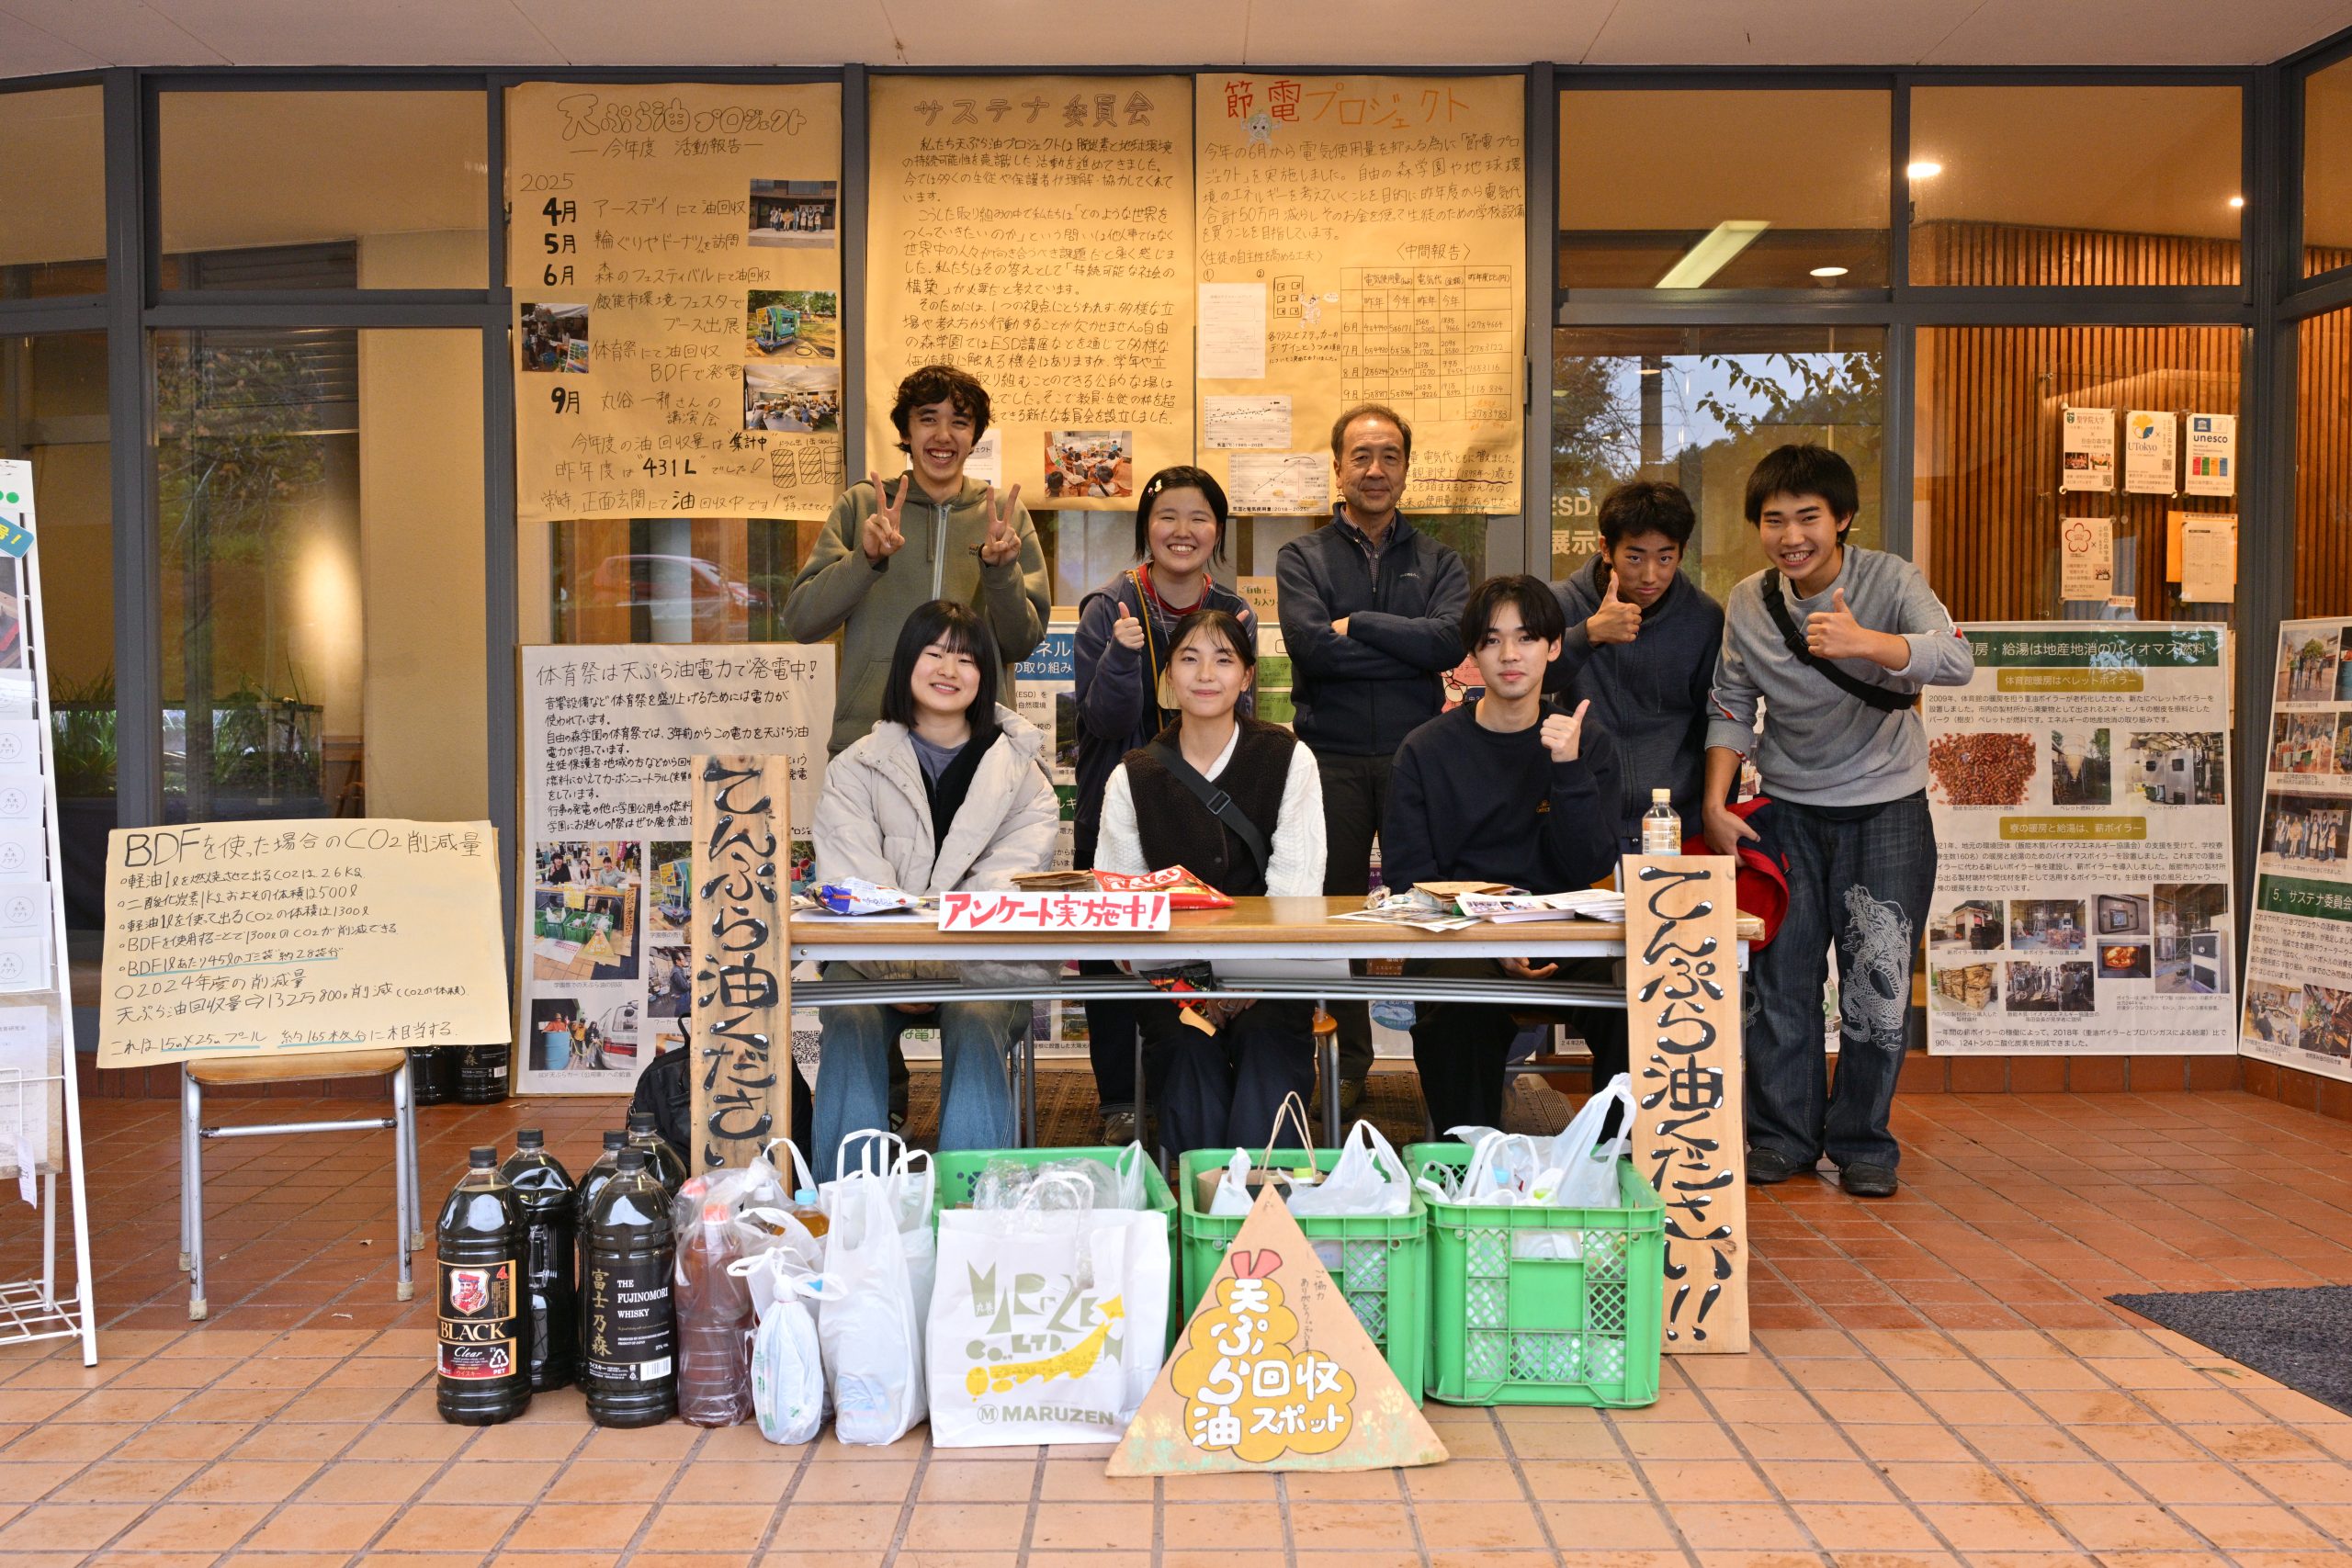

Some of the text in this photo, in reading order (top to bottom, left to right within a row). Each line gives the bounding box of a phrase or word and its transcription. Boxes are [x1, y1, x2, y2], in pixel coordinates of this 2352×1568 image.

[520, 172, 575, 192] 2025
[542, 197, 577, 227] 4月
[544, 233, 577, 254] 5月
[543, 264, 574, 287] 6月
[1343, 322, 1358, 333] 6月
[1343, 346, 1358, 355] 7月
[1343, 367, 1359, 378] 8月
[550, 387, 581, 414] 9月
[1344, 389, 1358, 399] 9月
[2128, 442, 2157, 452] UTokyo
[2193, 434, 2228, 444] unesco
[617, 1280, 634, 1288] THE
[617, 1287, 668, 1303] FUJINOMORI
[592, 1269, 612, 1357] 富士乃森
[617, 1309, 650, 1318] WHISKY
[441, 1323, 505, 1341] BLACK
[454, 1347, 482, 1358] Clear
[1251, 1355, 1343, 1402] 回収
[1001, 1405, 1114, 1425] MARUZEN
[1250, 1404, 1344, 1434] スポット
